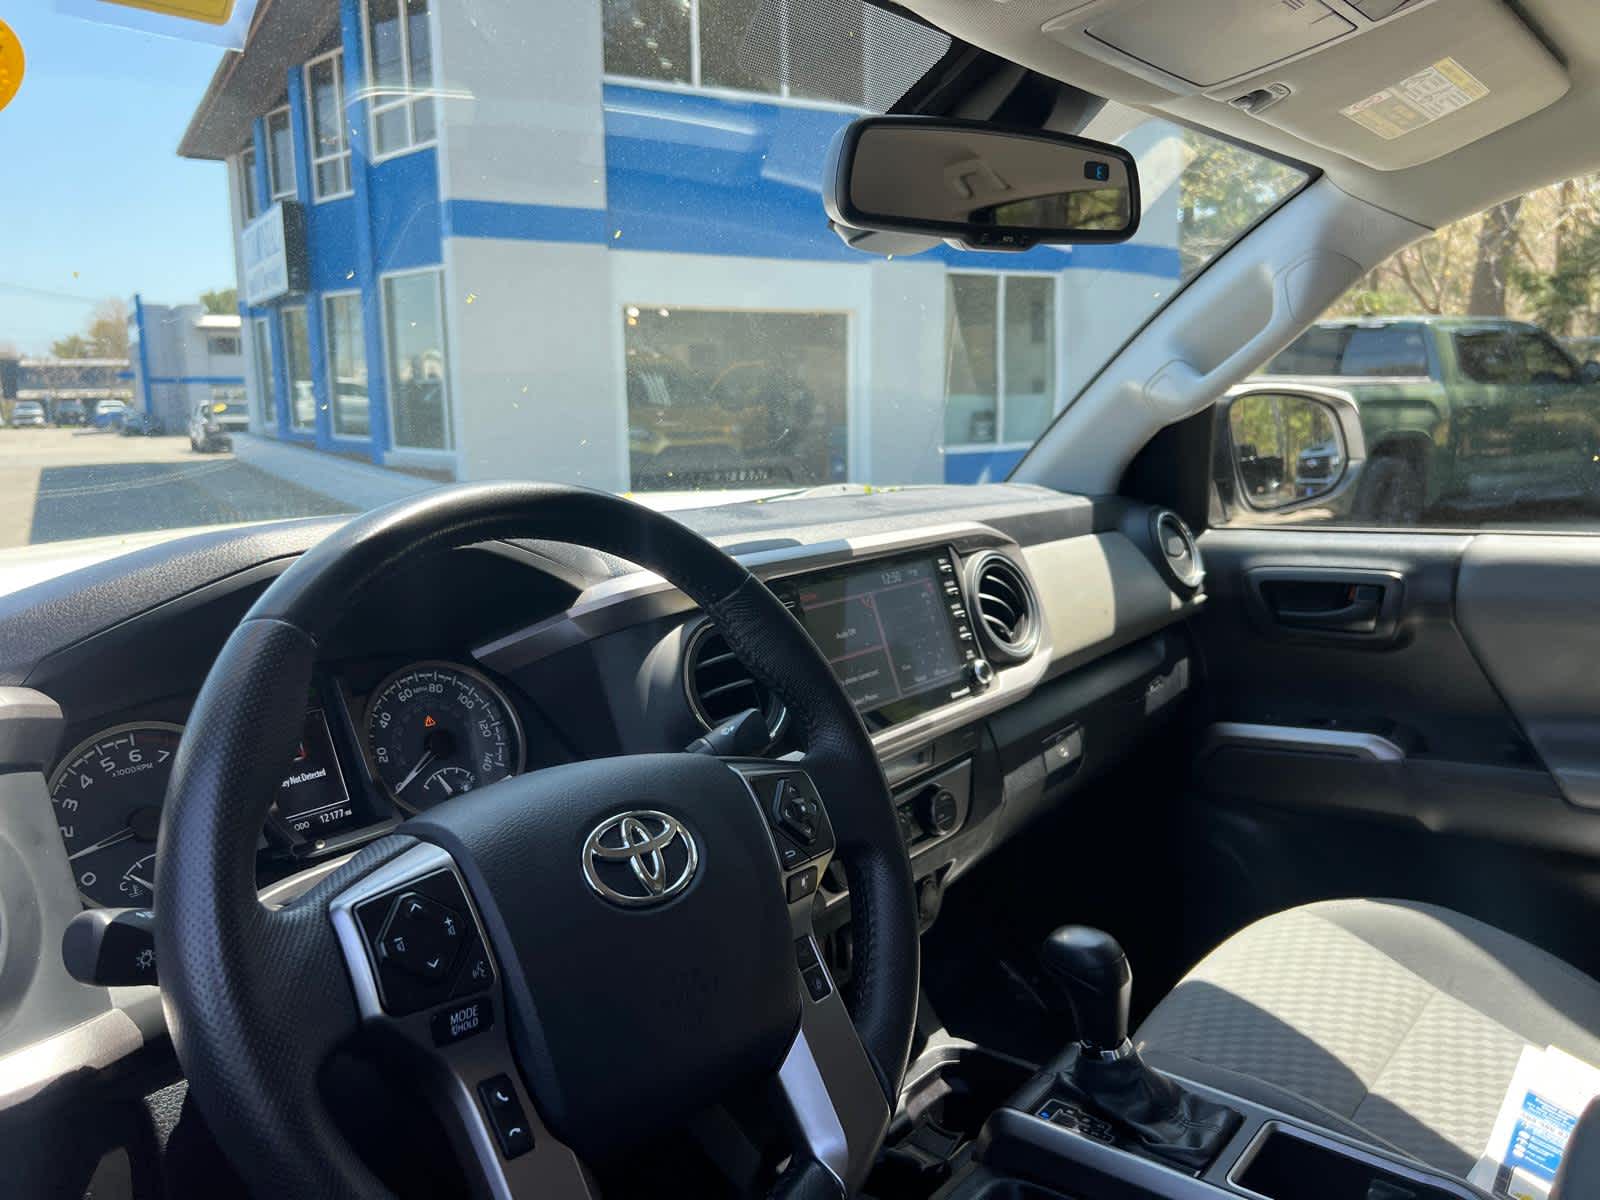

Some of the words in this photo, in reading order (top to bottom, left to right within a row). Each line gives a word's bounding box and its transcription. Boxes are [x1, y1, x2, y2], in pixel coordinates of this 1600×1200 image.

[398, 688, 413, 702] 60
[428, 683, 443, 693] 80
[457, 693, 475, 709] 100
[379, 712, 391, 728] 40
[478, 719, 492, 737] 120
[129, 749, 142, 762] 6
[158, 750, 170, 762] 7
[377, 747, 389, 763] 20
[482, 752, 493, 772] 140
[100, 757, 116, 772] 5
[81, 774, 93, 789] 4
[289, 775, 301, 785] Not
[301, 768, 327, 782] Detected
[62, 799, 78, 811] 3
[294, 821, 310, 831] ODO
[320, 809, 343, 823] 12177
[60, 826, 74, 837] 2
[81, 872, 96, 886] 0
[120, 882, 128, 891] C
[450, 1005, 479, 1025] MODE
[457, 1017, 479, 1033] HOLD
